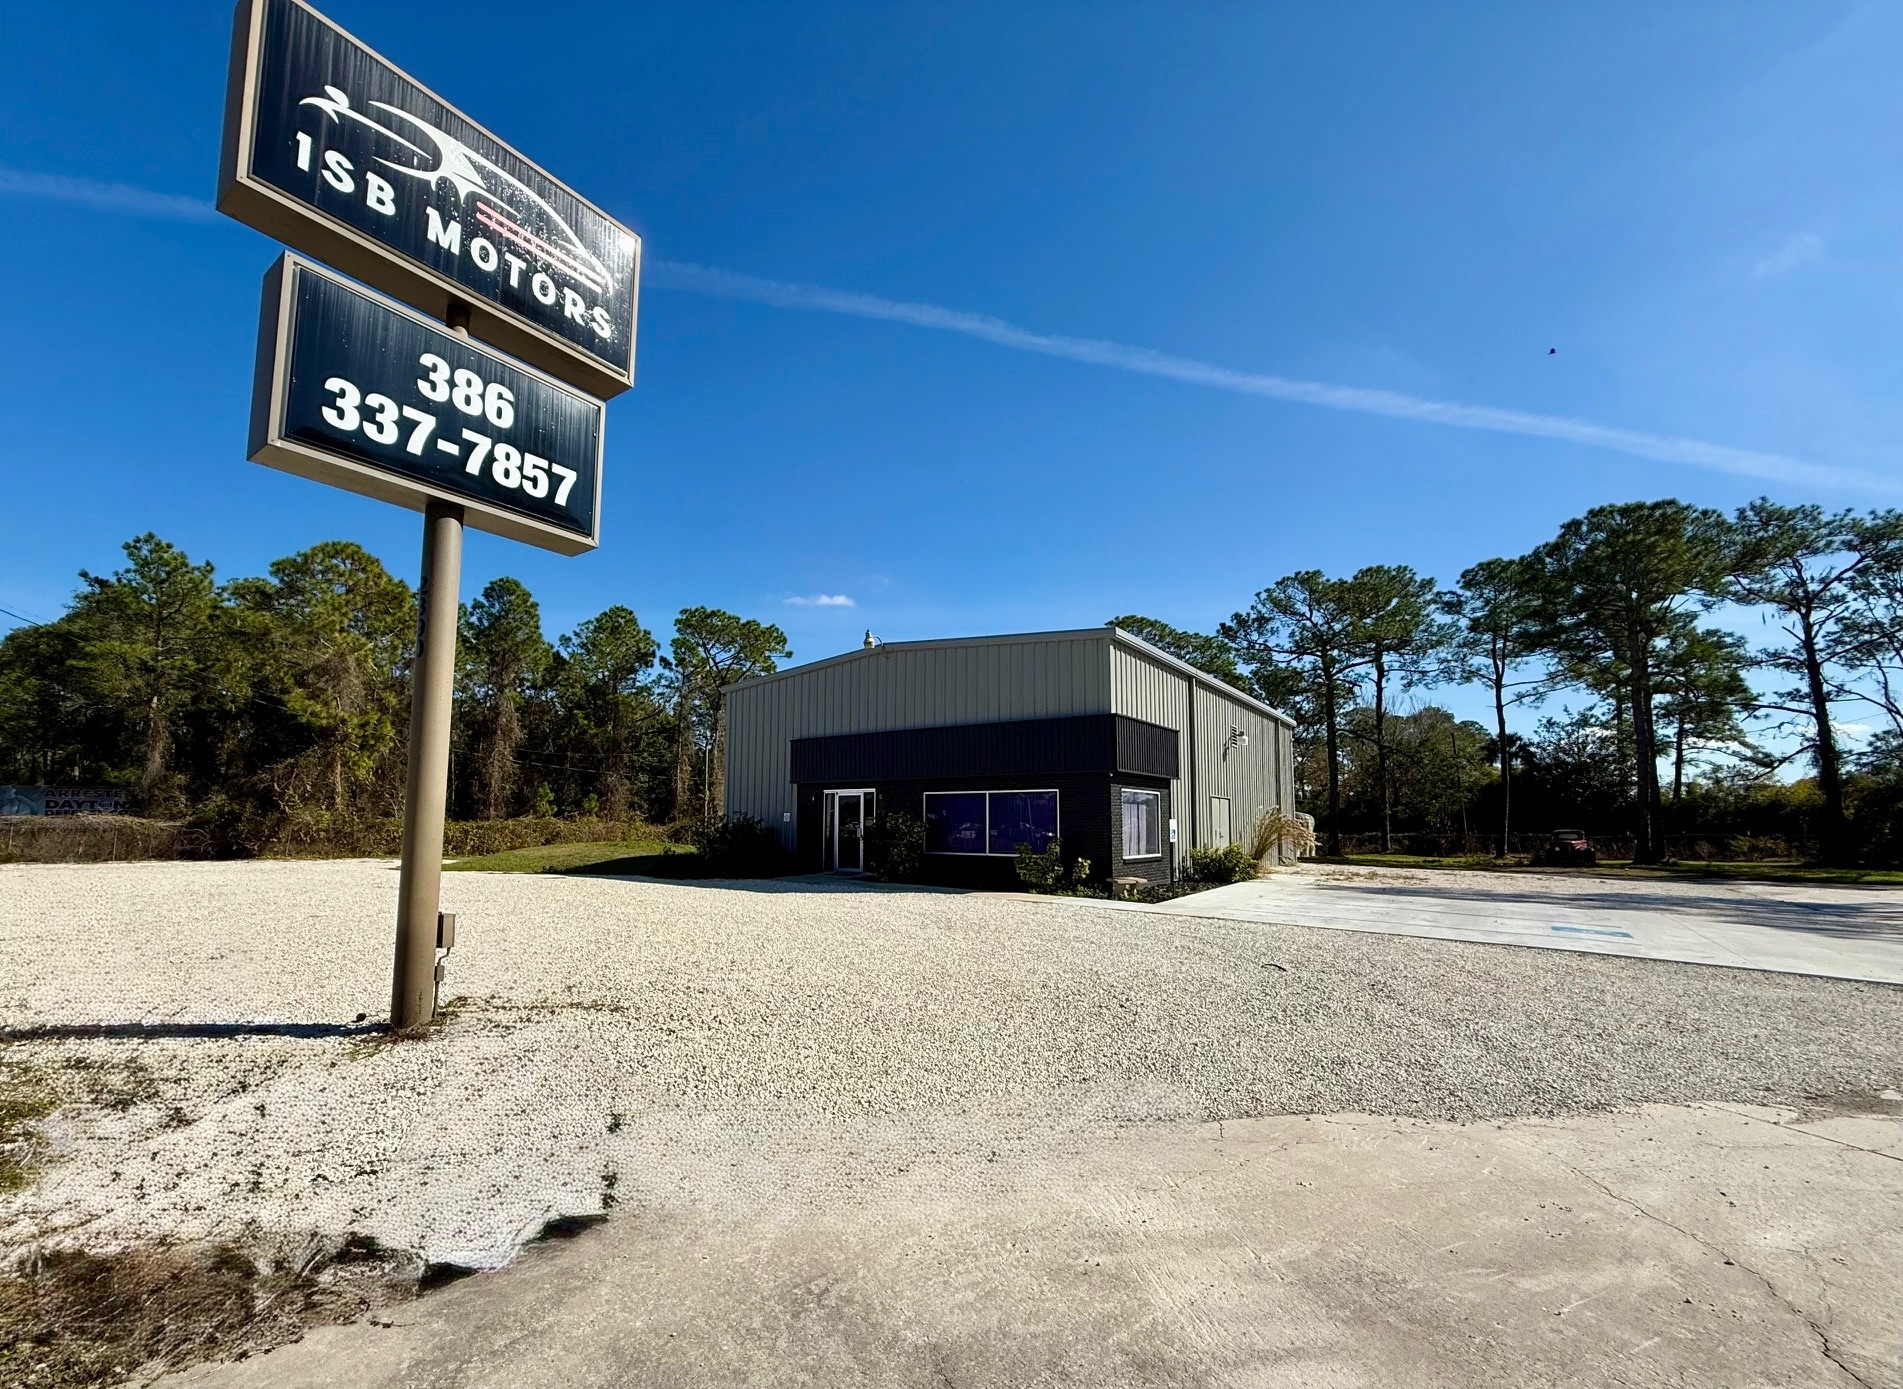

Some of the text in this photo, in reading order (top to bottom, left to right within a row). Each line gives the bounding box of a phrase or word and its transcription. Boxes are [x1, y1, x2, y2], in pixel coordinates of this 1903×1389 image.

[295, 130, 613, 340] 1SB MOTORS
[417, 353, 515, 429] 386
[321, 377, 578, 507] 337-7857
[44, 788, 123, 798] ARRESTE
[45, 799, 127, 810] DAYTON
